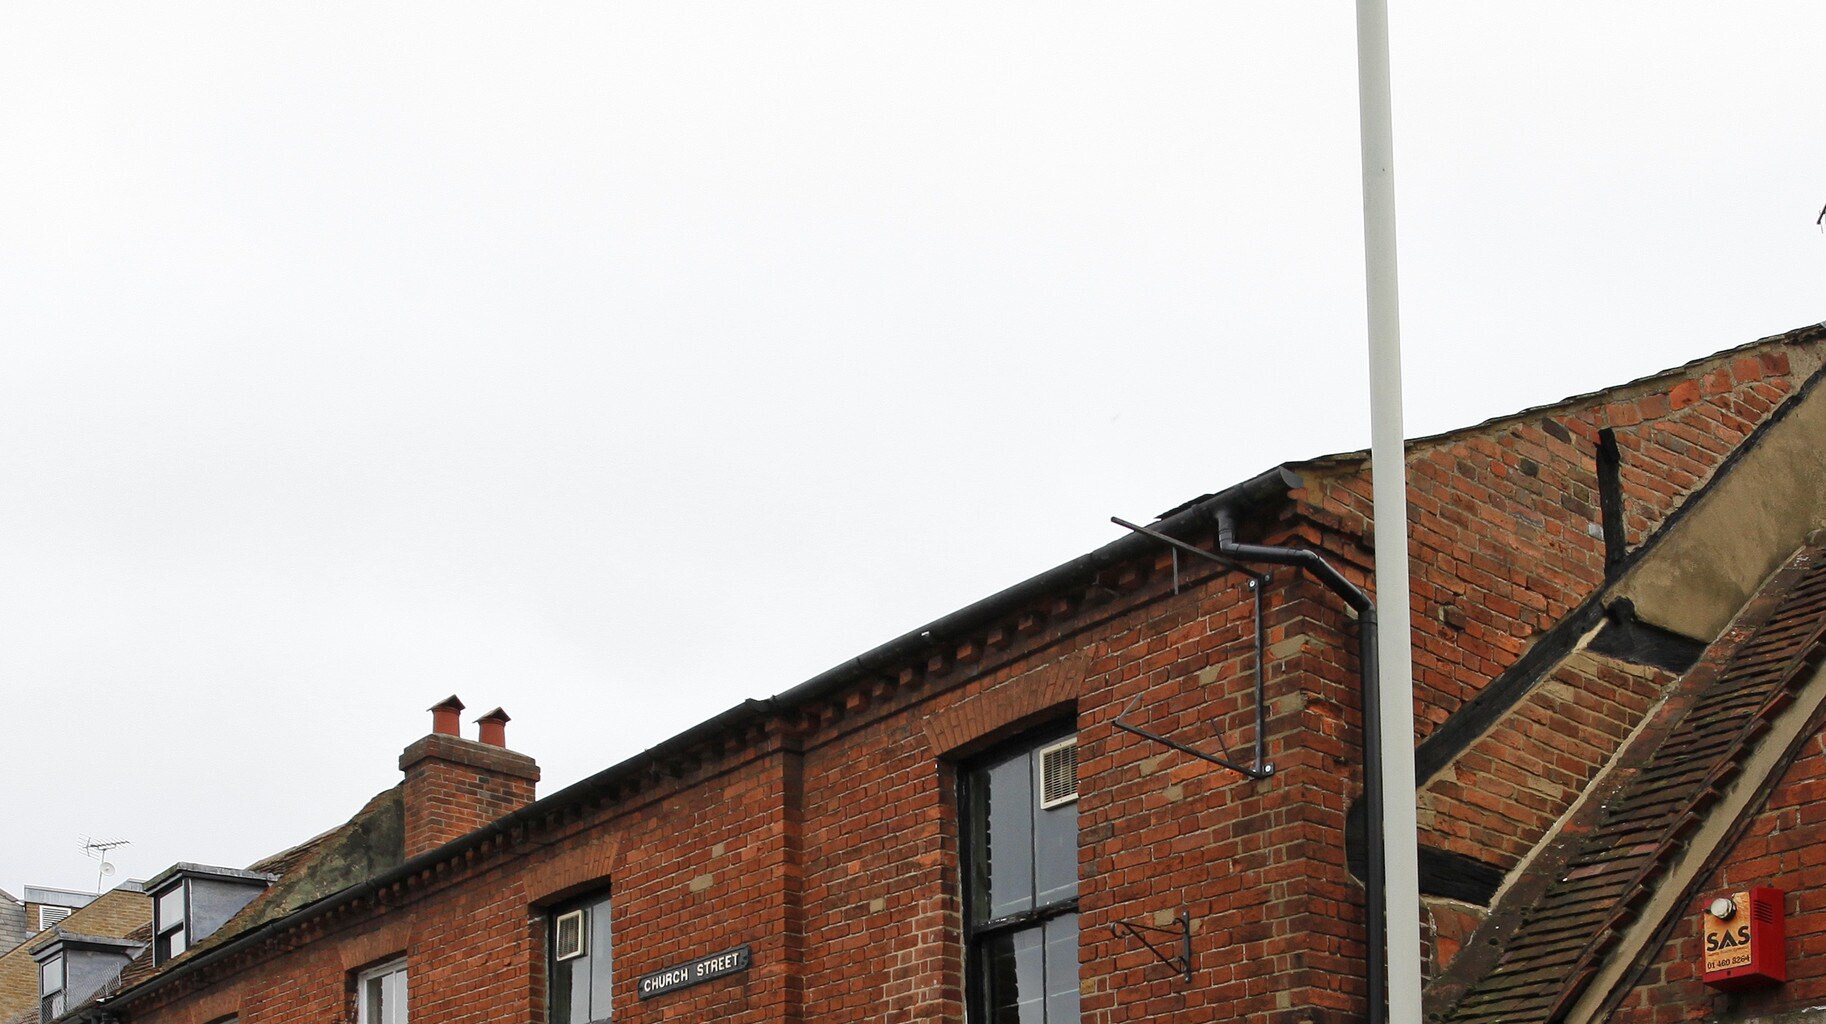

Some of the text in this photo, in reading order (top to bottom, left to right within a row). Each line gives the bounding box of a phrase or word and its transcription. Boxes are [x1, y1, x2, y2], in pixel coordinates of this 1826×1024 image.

[1706, 925, 1751, 952] SAS
[644, 952, 740, 992] CHURCH STREET
[1707, 962, 1715, 970] 01
